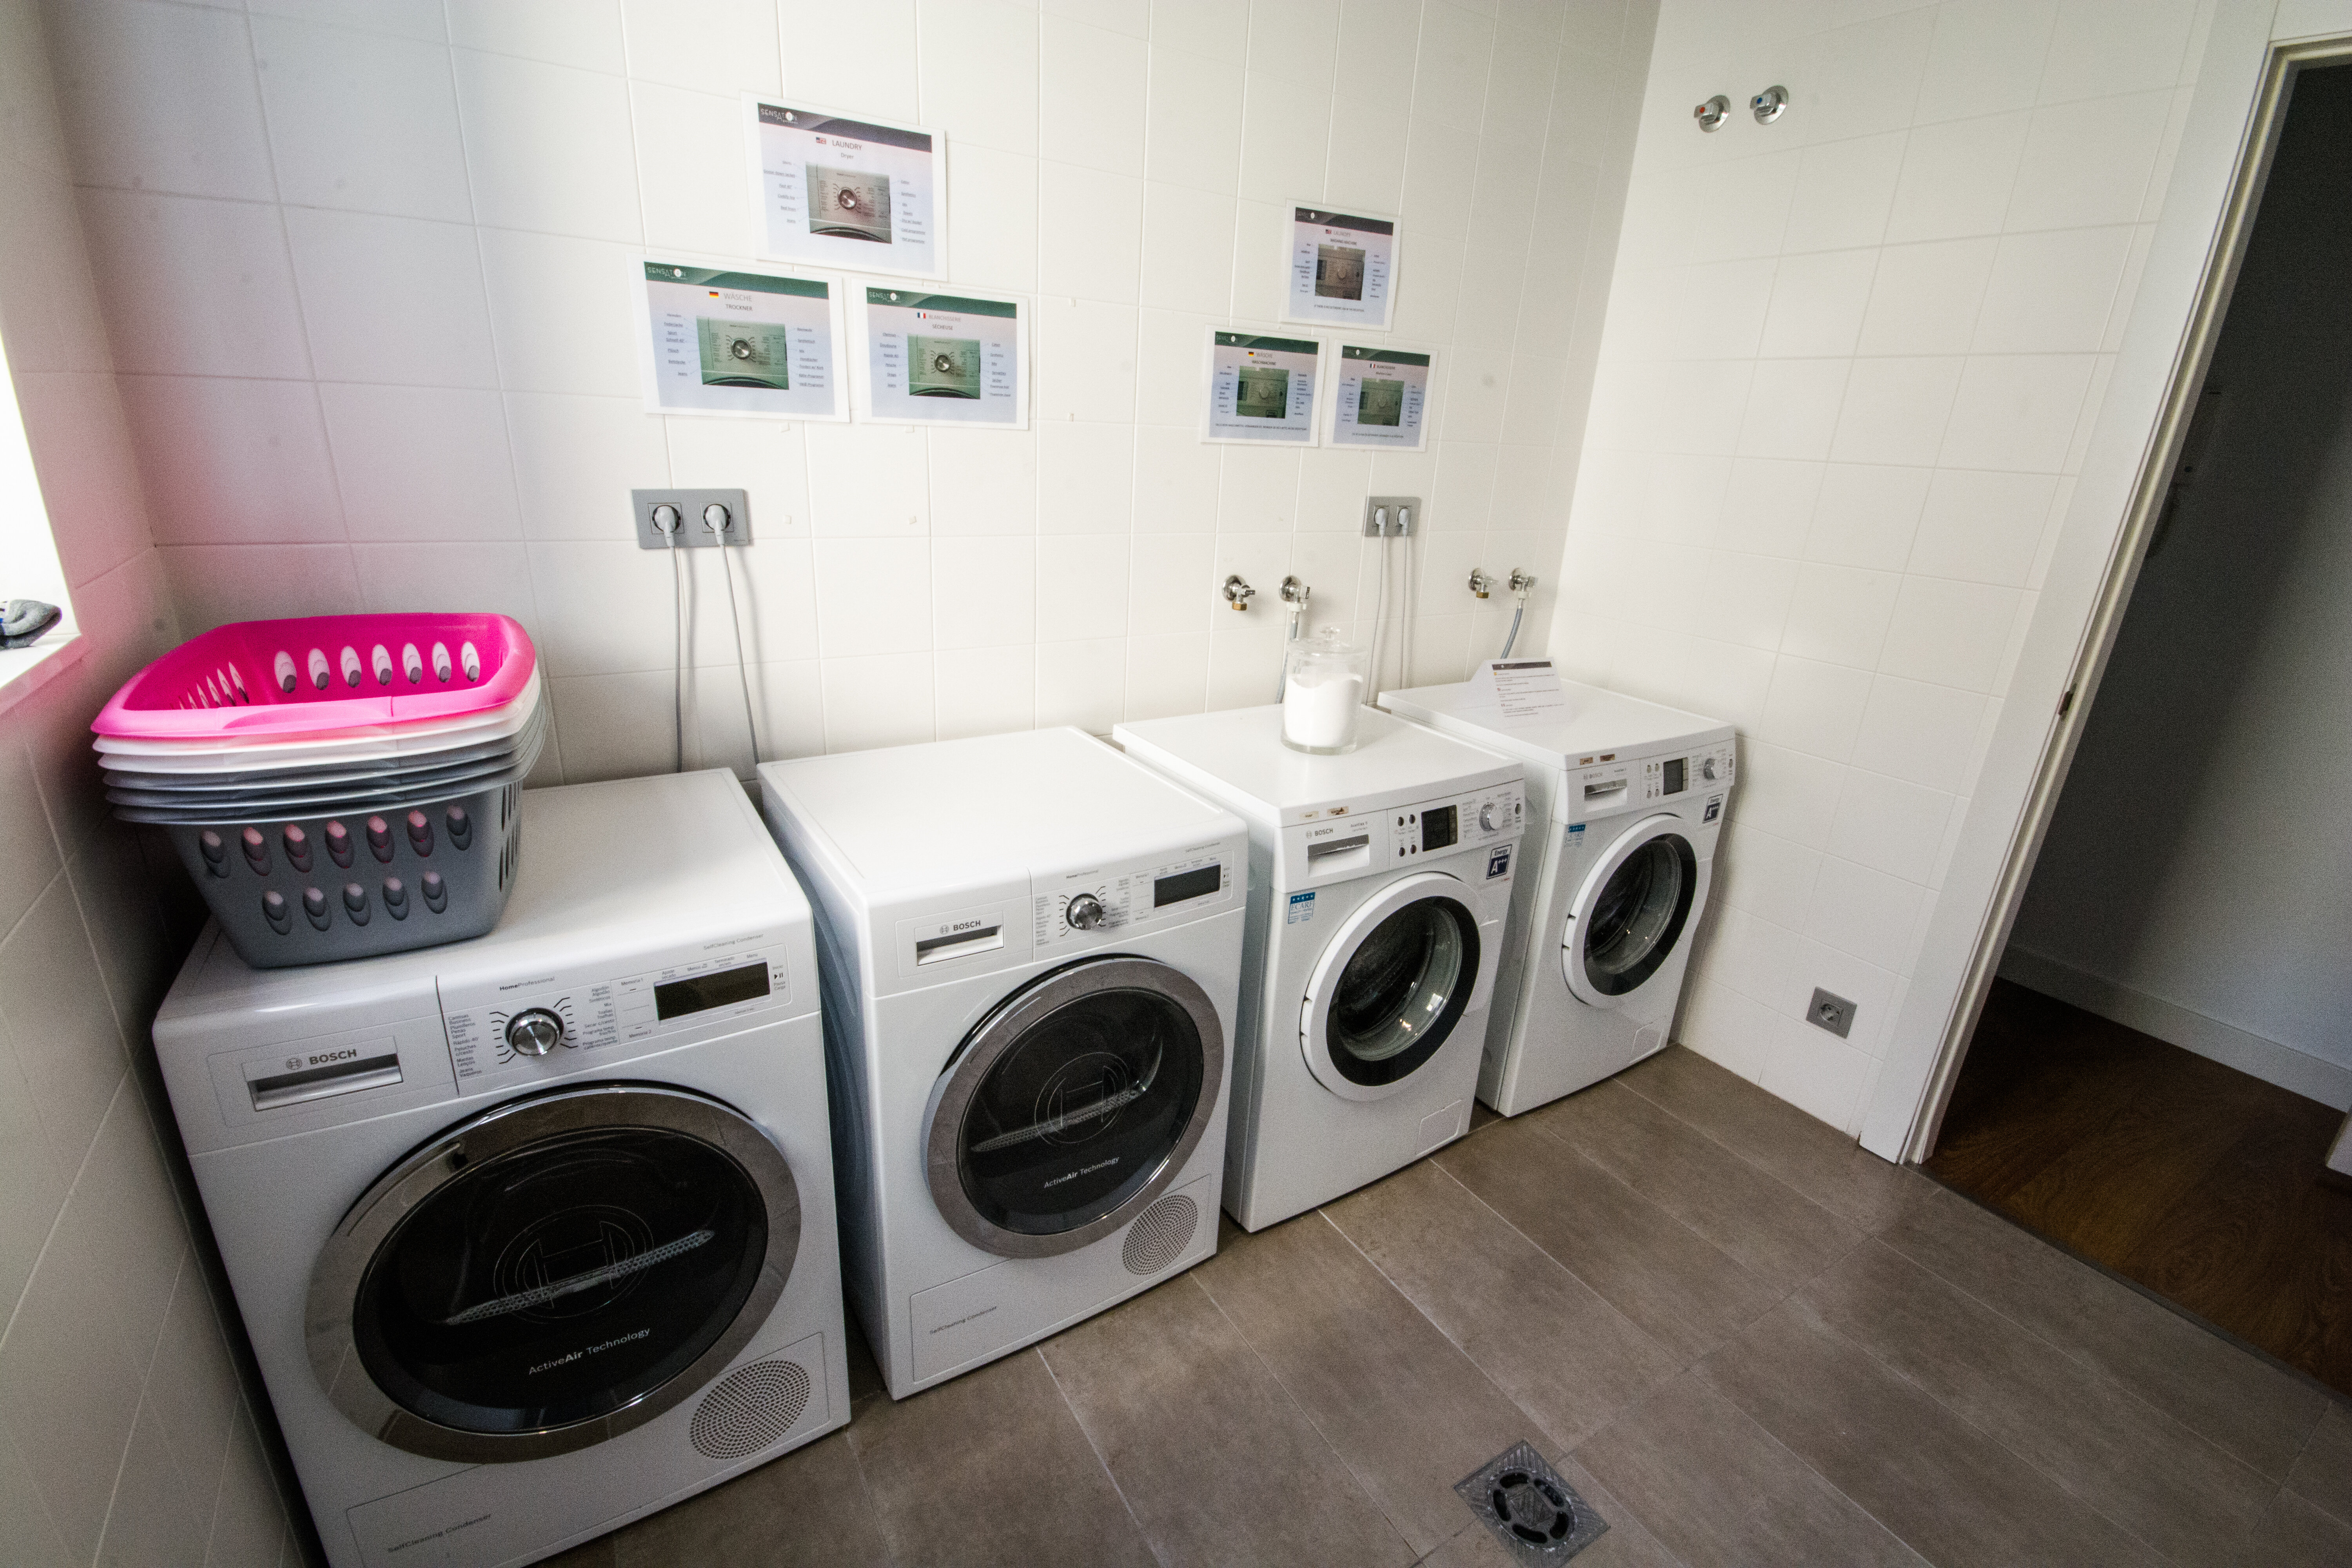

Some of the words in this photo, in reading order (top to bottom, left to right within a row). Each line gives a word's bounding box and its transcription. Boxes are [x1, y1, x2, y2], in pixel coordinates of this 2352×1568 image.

[832, 140, 862, 151] LAUNDRY
[1315, 828, 1333, 836] BOSCH
[1494, 848, 1508, 857] Energy
[953, 920, 981, 931] BOSCH
[704, 940, 735, 950] SelfCleaning
[499, 975, 555, 991] HomeProfessional
[309, 1049, 357, 1065] BOSCH
[1044, 1172, 1078, 1189] ActiveAir
[1080, 1156, 1120, 1175] Technology
[528, 1351, 584, 1375] ActiveAir
[586, 1328, 650, 1355] Technology
